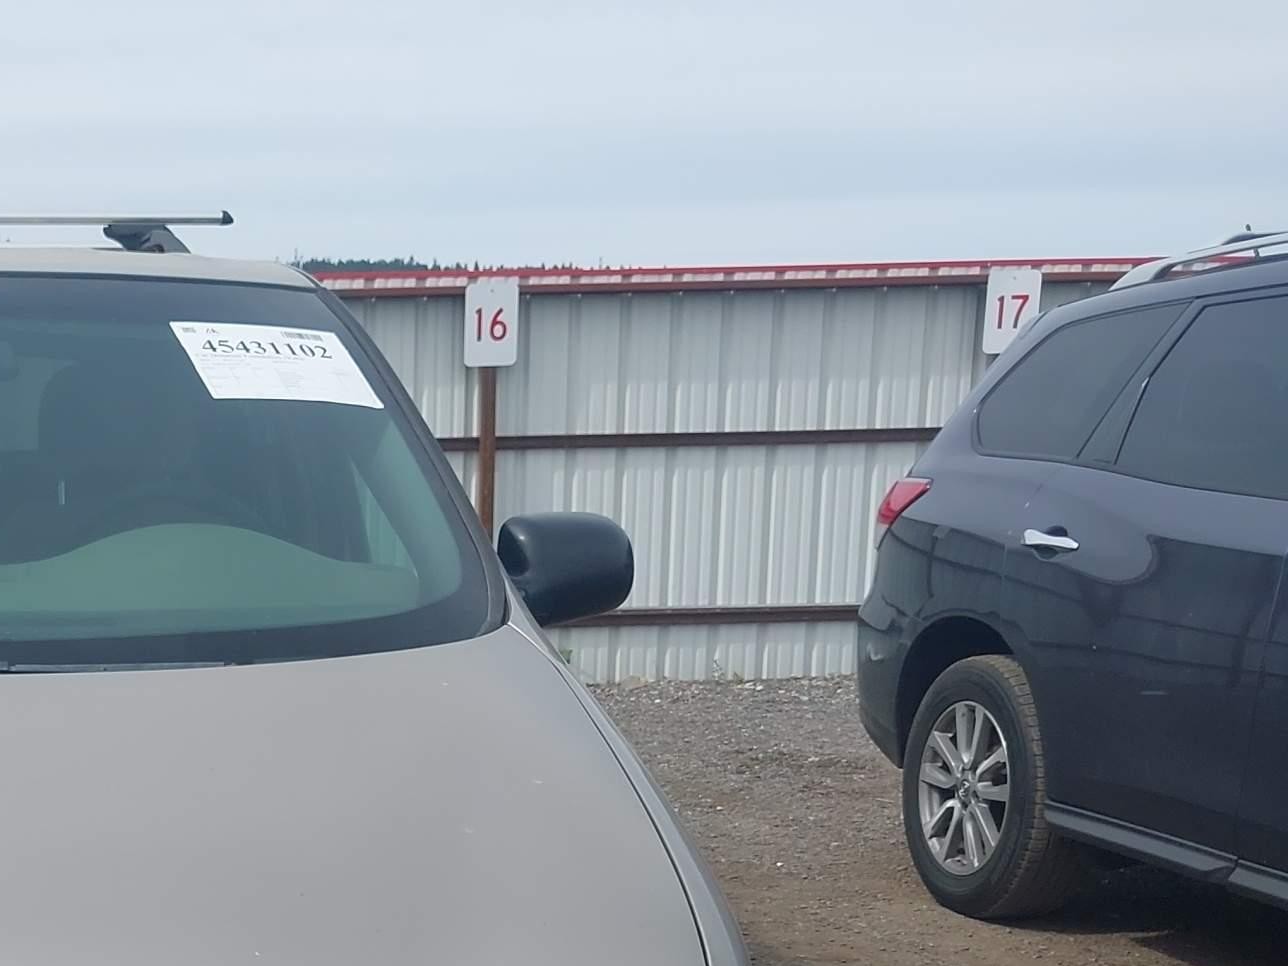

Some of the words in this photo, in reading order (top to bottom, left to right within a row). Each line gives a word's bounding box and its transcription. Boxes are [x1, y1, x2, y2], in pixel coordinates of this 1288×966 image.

[474, 307, 508, 342] 16
[997, 295, 1030, 329] 17
[201, 339, 333, 360] 45431102
